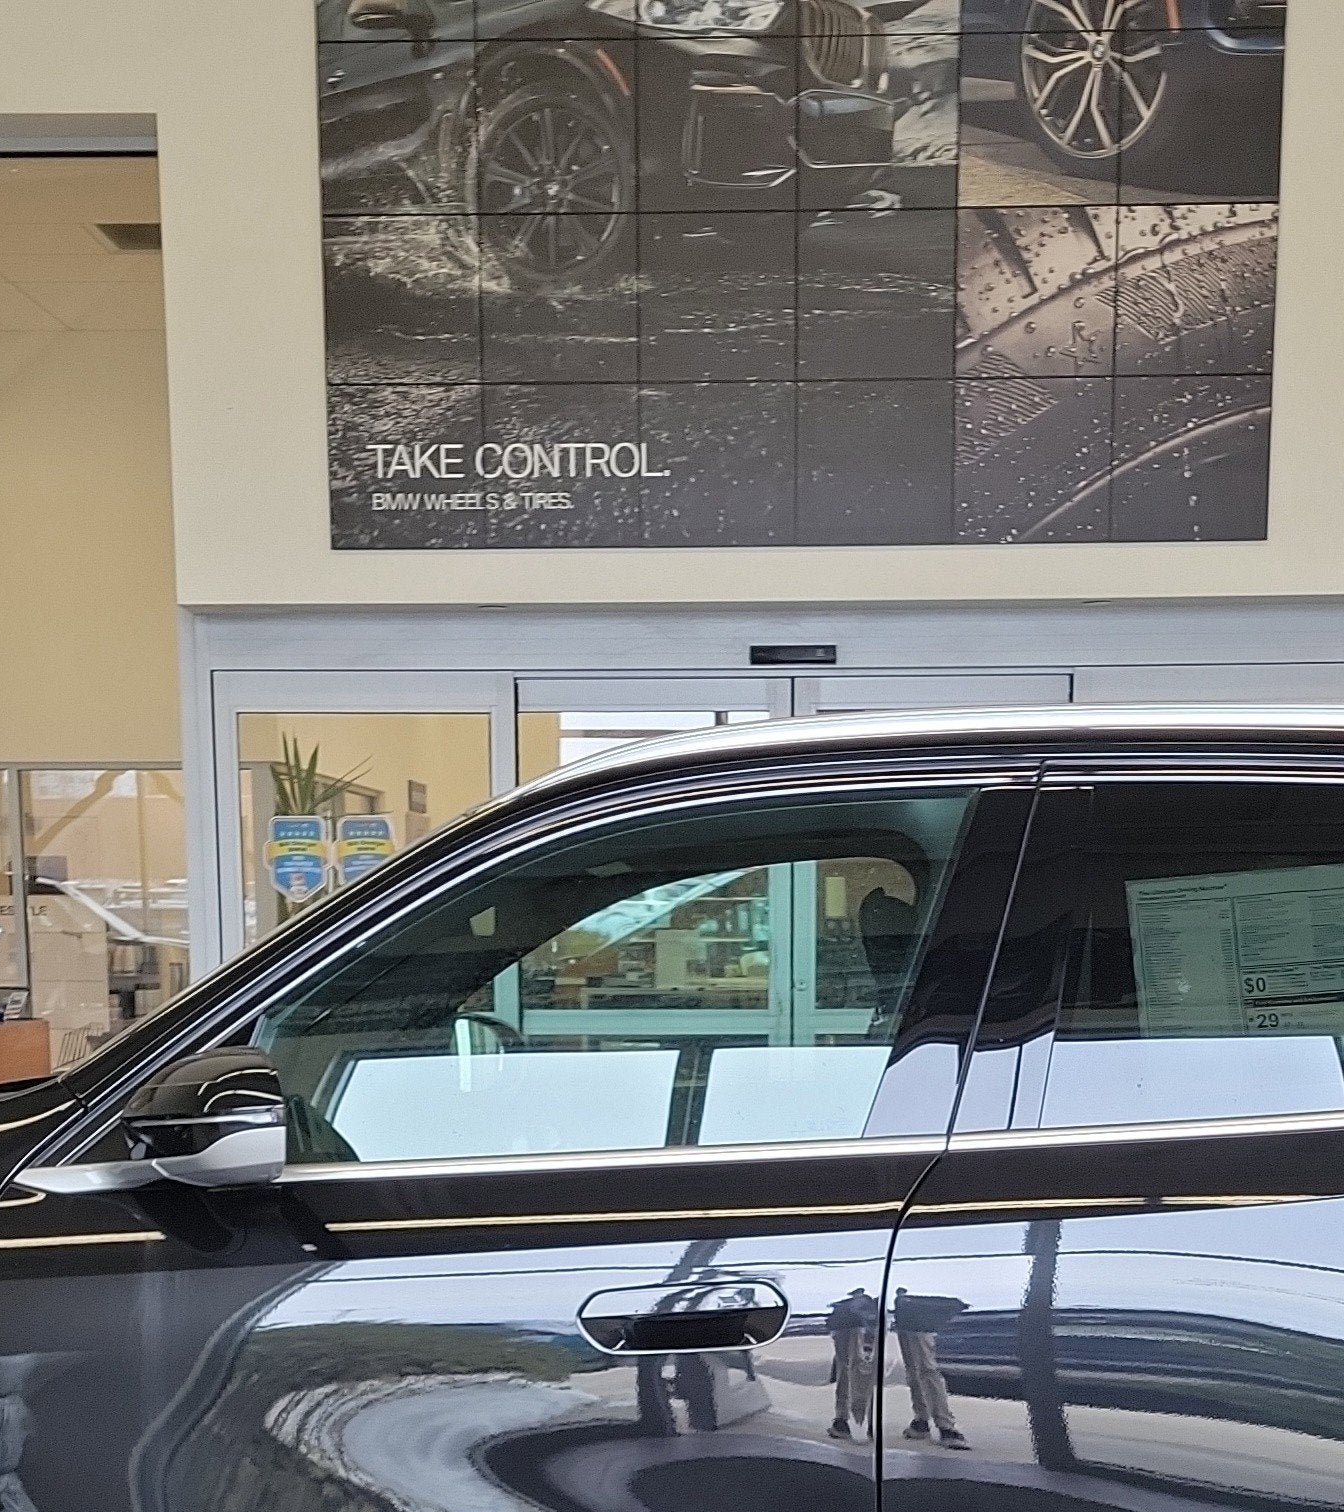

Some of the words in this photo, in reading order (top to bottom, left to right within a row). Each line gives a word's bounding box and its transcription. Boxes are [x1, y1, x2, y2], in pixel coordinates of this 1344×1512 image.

[365, 442, 467, 480] TAKE
[474, 441, 672, 480] CONTROL.
[370, 492, 420, 511] BMW
[424, 492, 500, 511] WHEELS
[502, 492, 519, 510] &
[1243, 976, 1267, 995] $0
[1256, 1012, 1280, 1029] 29
